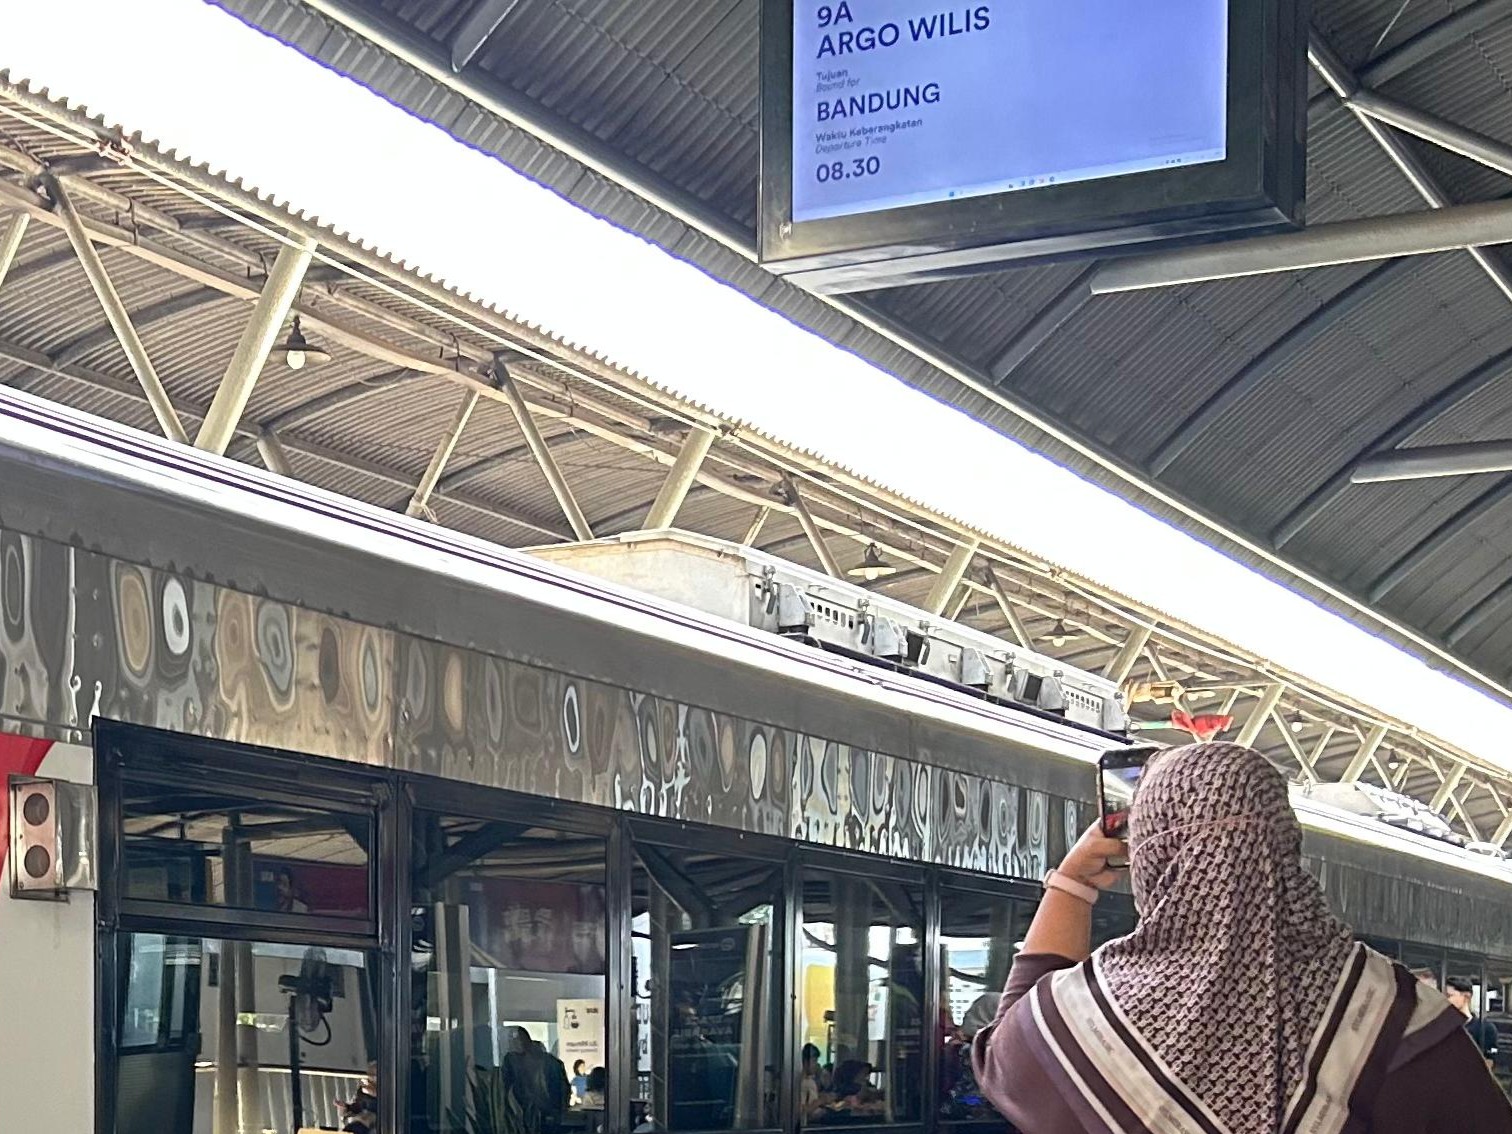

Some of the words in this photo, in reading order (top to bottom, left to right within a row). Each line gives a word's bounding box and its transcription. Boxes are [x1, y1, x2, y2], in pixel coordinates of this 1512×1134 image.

[817, 1, 853, 28] 9A
[816, 23, 900, 59] ARGO
[908, 6, 990, 41] WILIS
[816, 69, 848, 82] Tujuan
[817, 83, 940, 121] BANDUNG
[849, 118, 923, 138] Keberangkatan
[816, 156, 880, 183] 08.30
